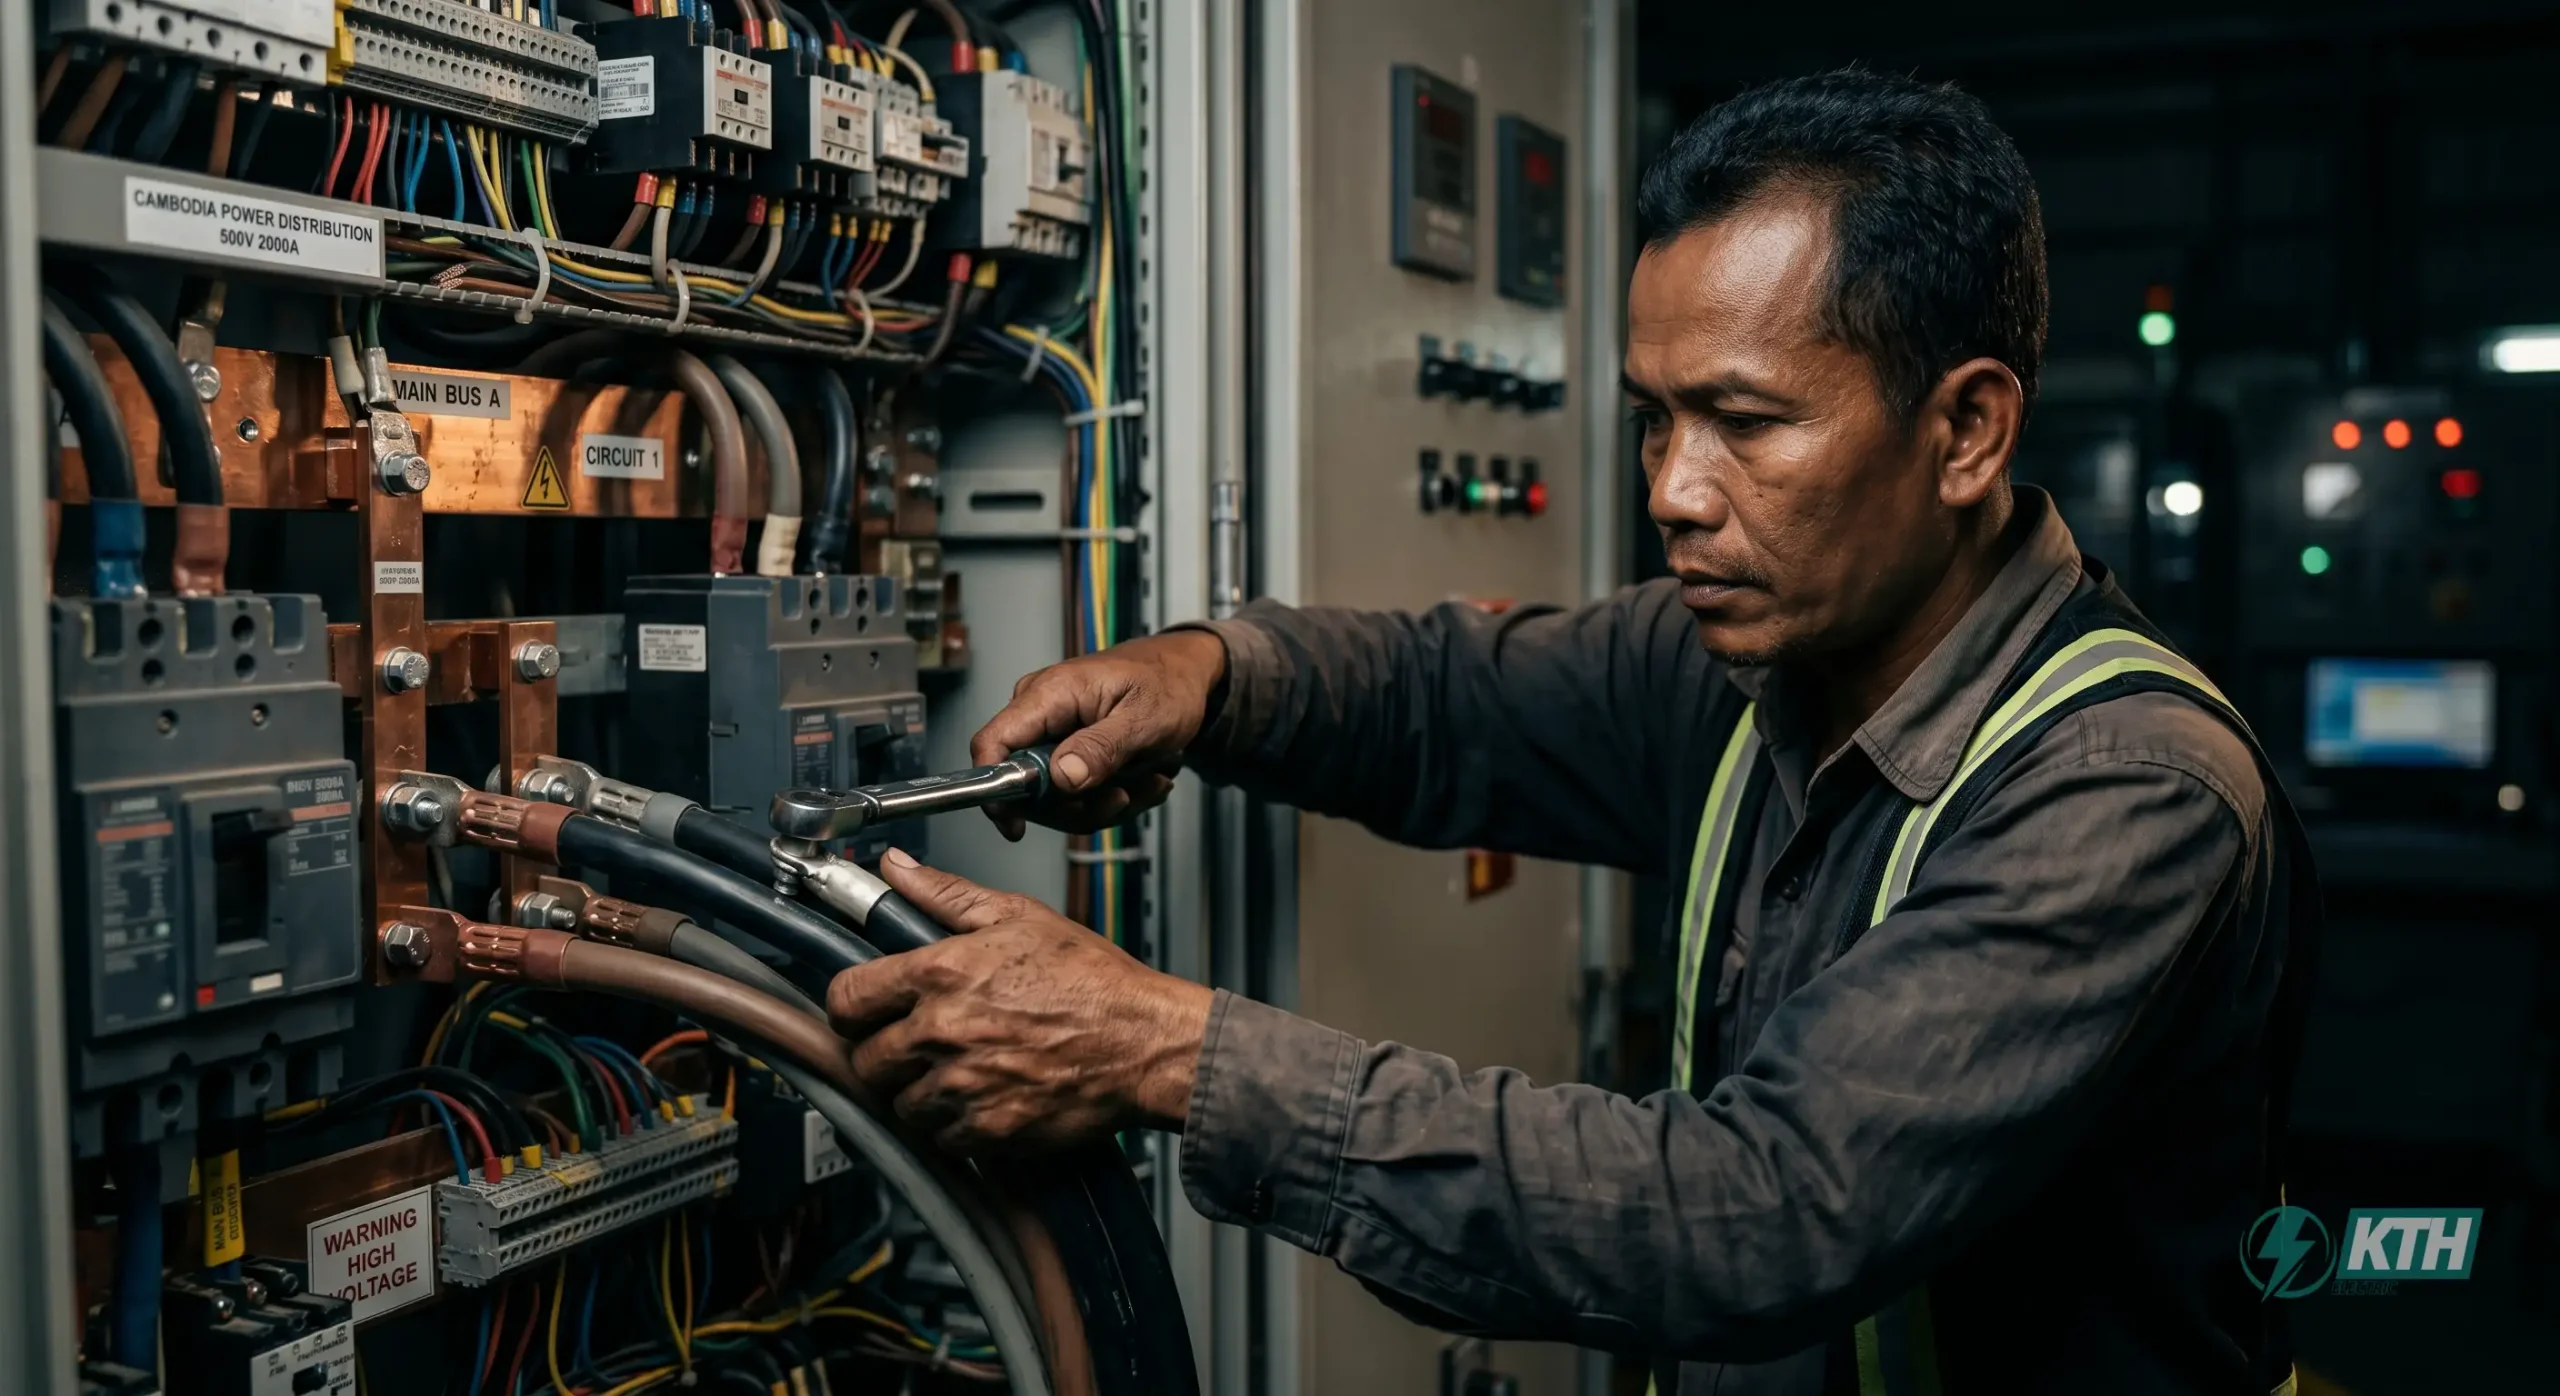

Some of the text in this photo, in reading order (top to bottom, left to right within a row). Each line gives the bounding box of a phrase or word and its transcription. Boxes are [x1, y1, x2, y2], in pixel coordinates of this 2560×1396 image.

[134, 189, 373, 243] CAMBODIA POWER DISTRIBUTION
[219, 228, 300, 255] 500V 2000A
[392, 380, 501, 408] MAIN BUS A
[586, 446, 658, 468] CIRCUIT 1
[323, 1208, 417, 1256] WARNING
[347, 1242, 395, 1277] HIGH
